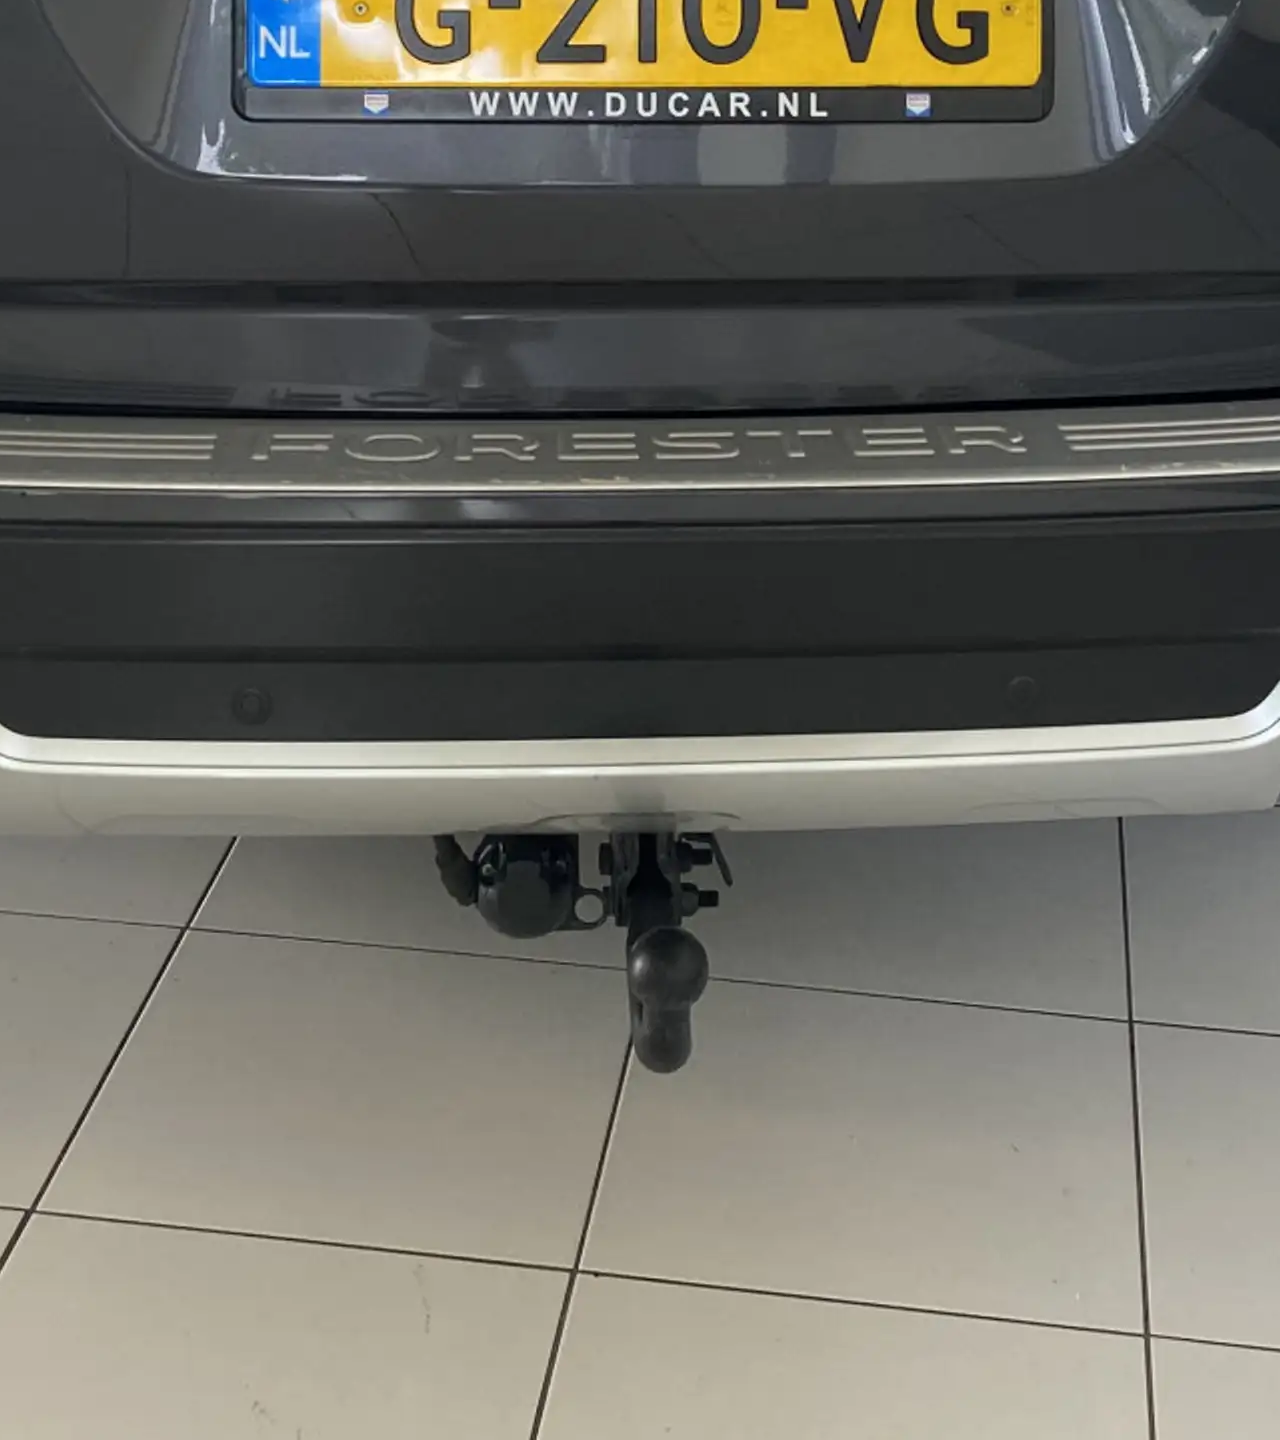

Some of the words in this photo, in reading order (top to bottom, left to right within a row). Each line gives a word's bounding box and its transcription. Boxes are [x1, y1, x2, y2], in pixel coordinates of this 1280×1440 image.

[258, 26, 311, 59] NL
[469, 91, 830, 118] WWW.DUCAR.NL
[251, 425, 1028, 462] FORESTER
